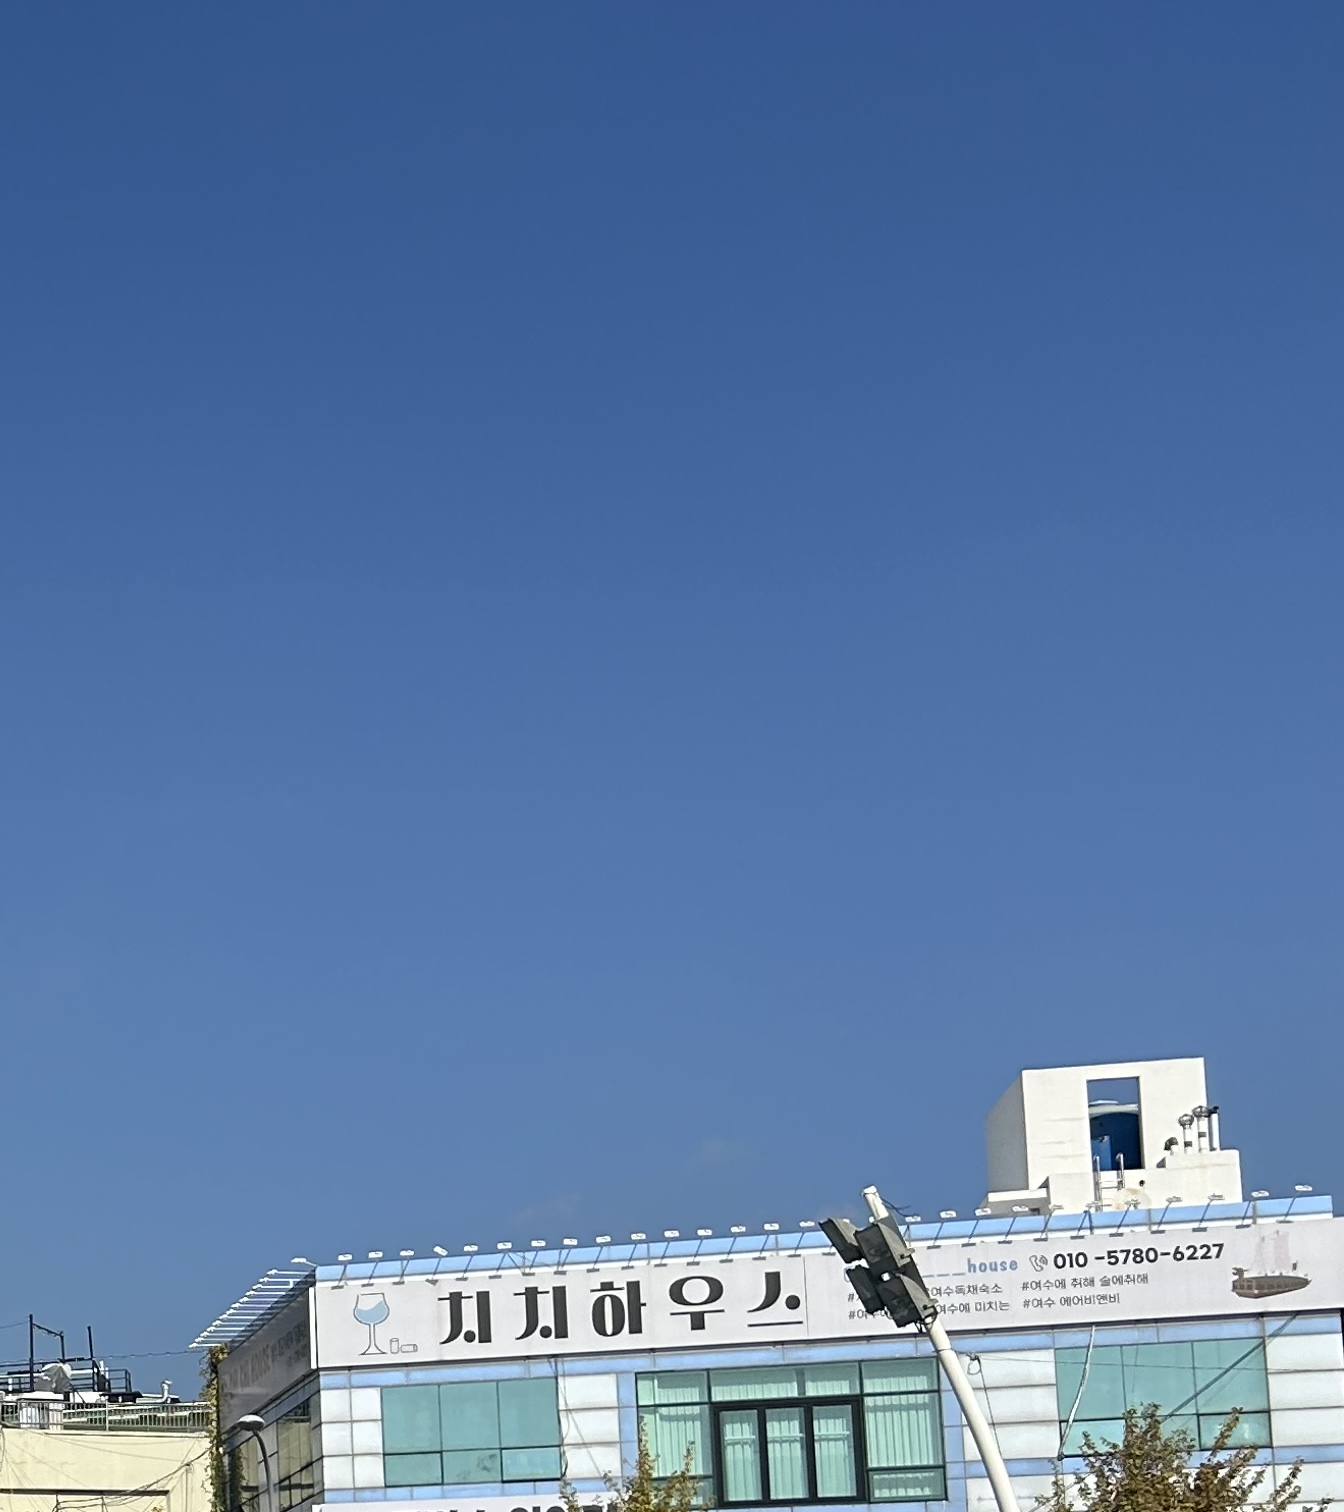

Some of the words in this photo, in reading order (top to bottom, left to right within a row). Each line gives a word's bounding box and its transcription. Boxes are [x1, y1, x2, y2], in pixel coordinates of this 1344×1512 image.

[1053, 1252, 1088, 1270] 010
[926, 1285, 1003, 1298] 여수독채숙소
[936, 1304, 971, 1315] 여수에
